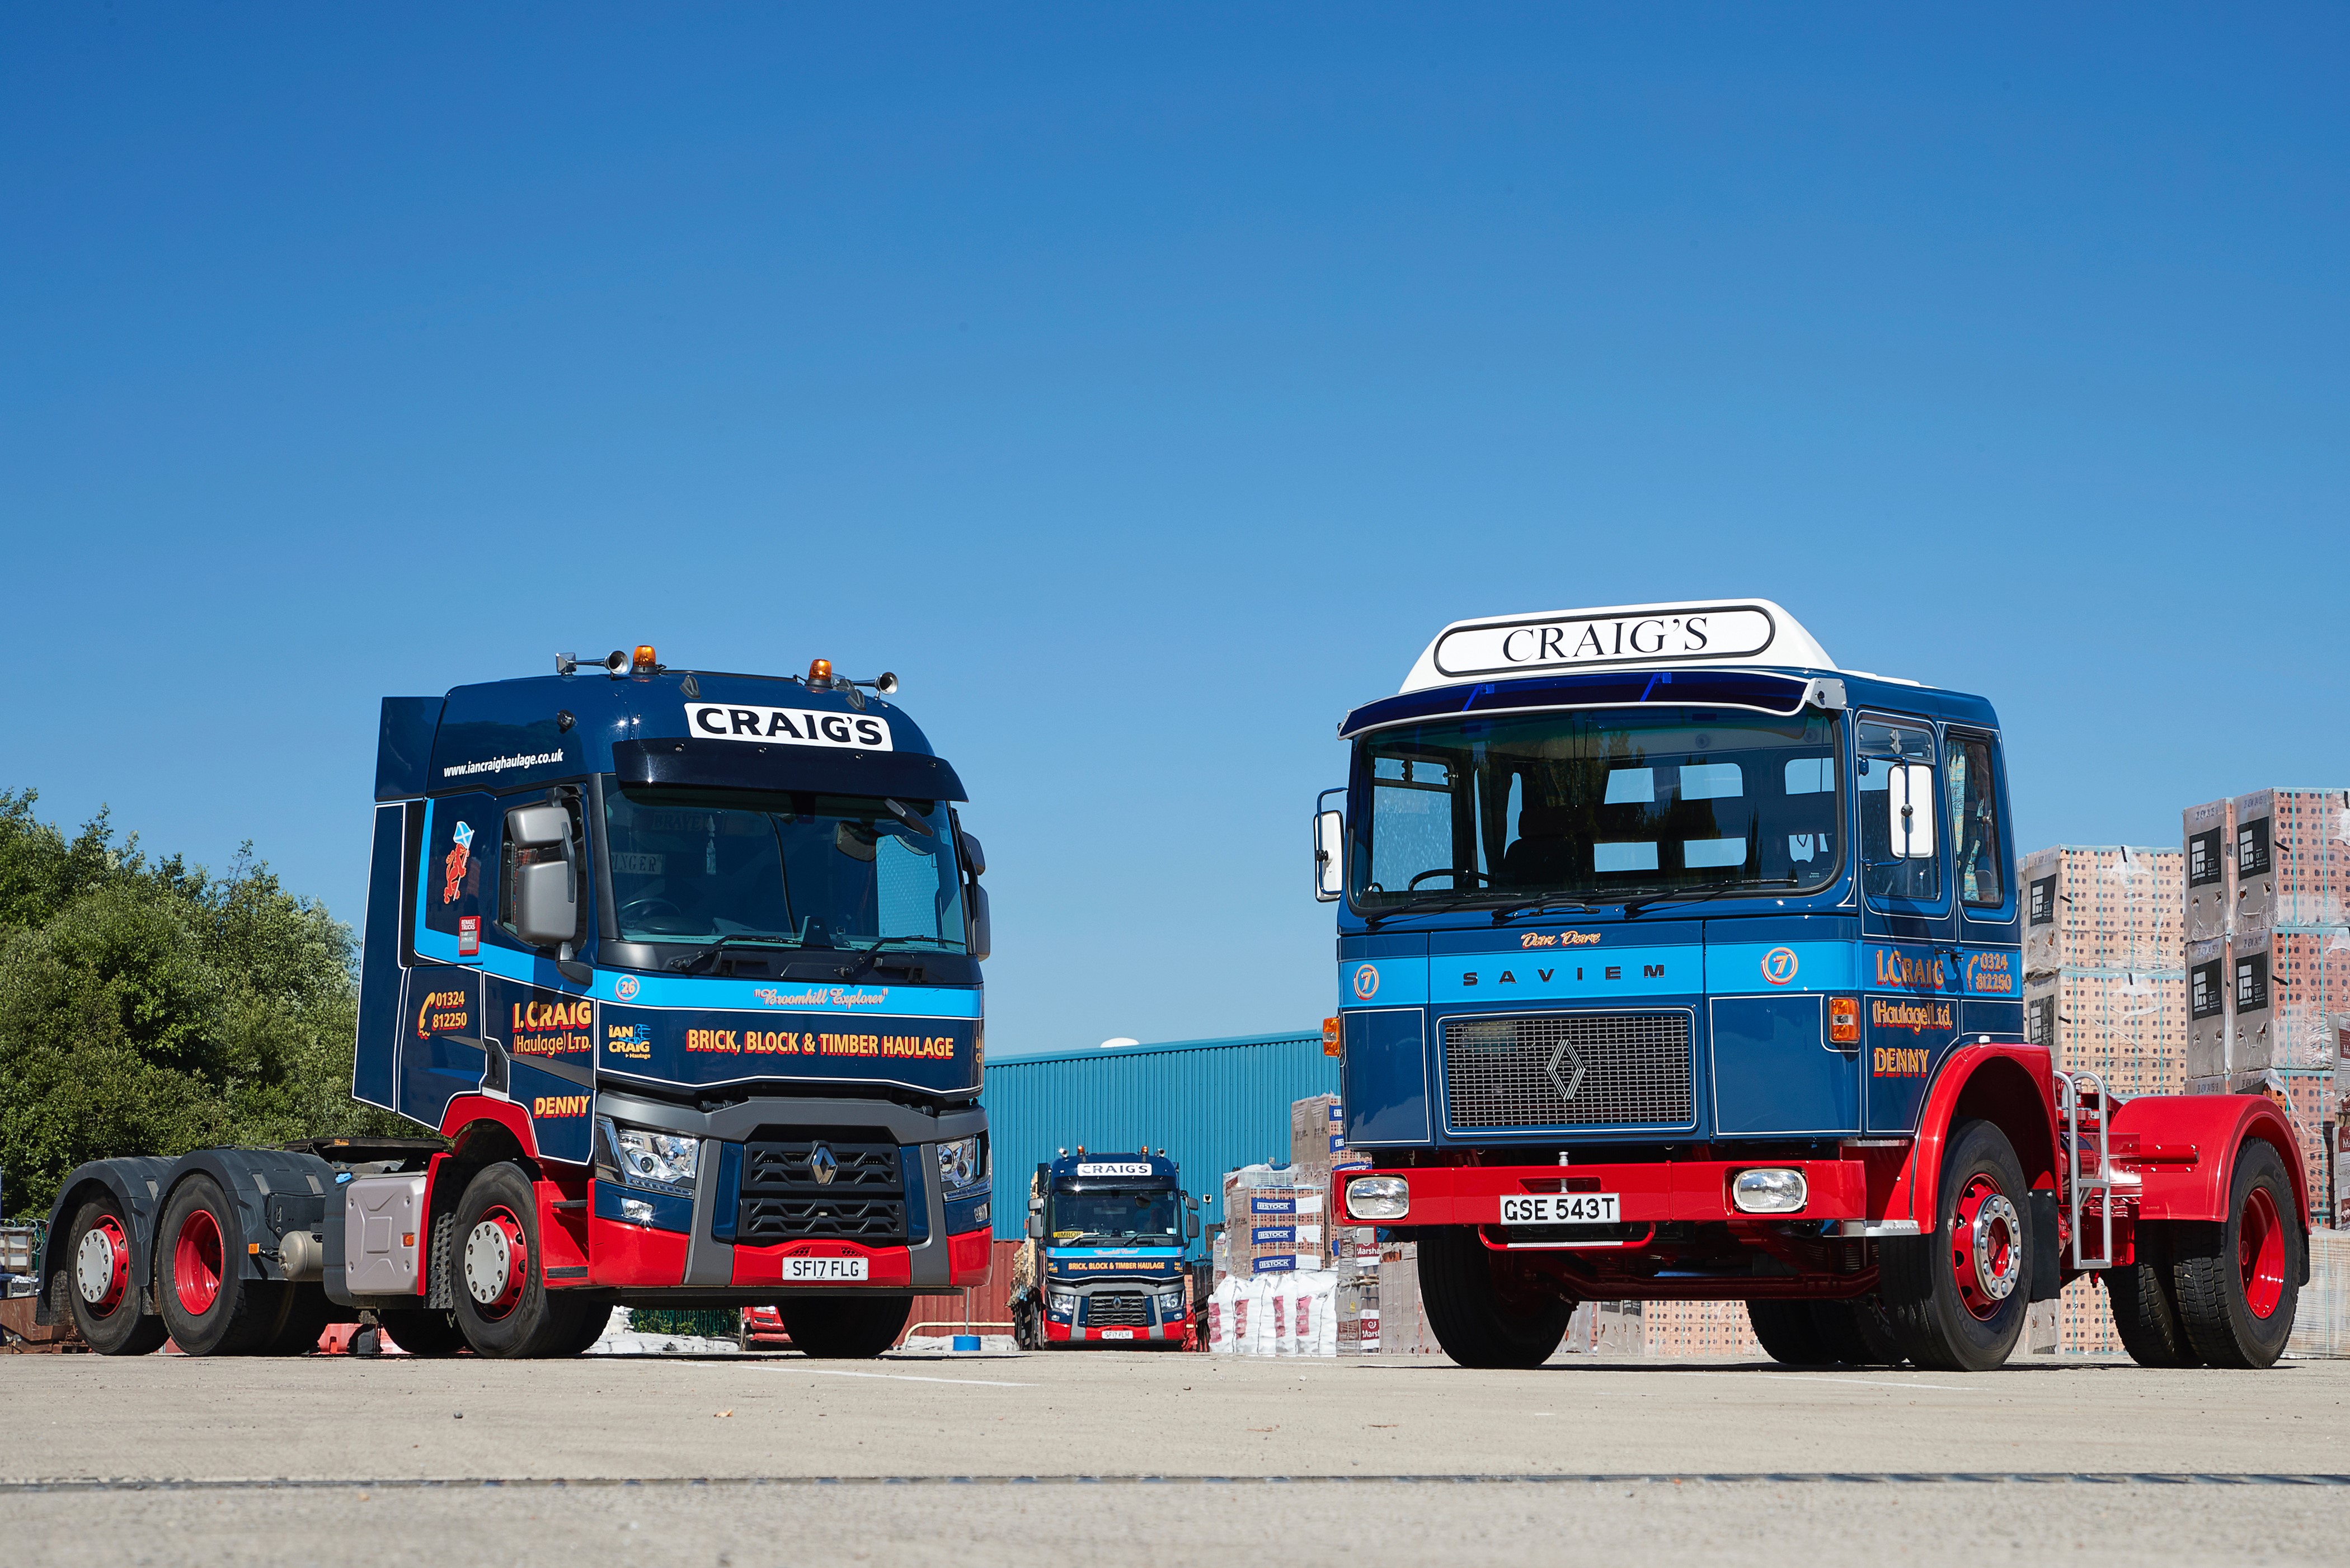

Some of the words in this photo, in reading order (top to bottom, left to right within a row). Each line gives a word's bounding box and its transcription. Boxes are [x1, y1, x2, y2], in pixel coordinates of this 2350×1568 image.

[1502, 616, 1708, 662] CRAIG'S
[696, 708, 883, 746] CRAIG'S
[444, 748, 563, 778] www.iancraighaulage.co.uk
[1521, 933, 1559, 949] Dan
[1561, 930, 1601, 947] Dare
[1772, 957, 1788, 976] 7
[1980, 952, 2008, 971] 0324
[1360, 971, 1373, 990] 7
[1463, 964, 1665, 986] SAVIEM
[1976, 973, 2012, 992] 812250
[621, 981, 636, 994] 26
[436, 990, 465, 1007] 01324
[433, 1013, 467, 1028] 812250
[688, 1029, 741, 1053] BRICK,
[746, 1031, 800, 1053] BLOCK
[803, 1033, 815, 1053] &
[820, 1033, 879, 1054] TIMBER
[883, 1035, 954, 1057] HAULAGE
[1874, 1048, 1930, 1073] DENNY
[535, 1095, 591, 1115] DENNY
[1081, 1164, 1148, 1174] CRAIG'S
[1504, 1199, 1548, 1221] GSE
[1555, 1198, 1615, 1220] 543T
[1258, 1231, 1289, 1239] IBSTOCK
[793, 1261, 826, 1277] SF17
[831, 1261, 859, 1277] FLG
[1068, 1262, 1088, 1270] BRICK,
[1259, 1259, 1289, 1269] IBSTOCK
